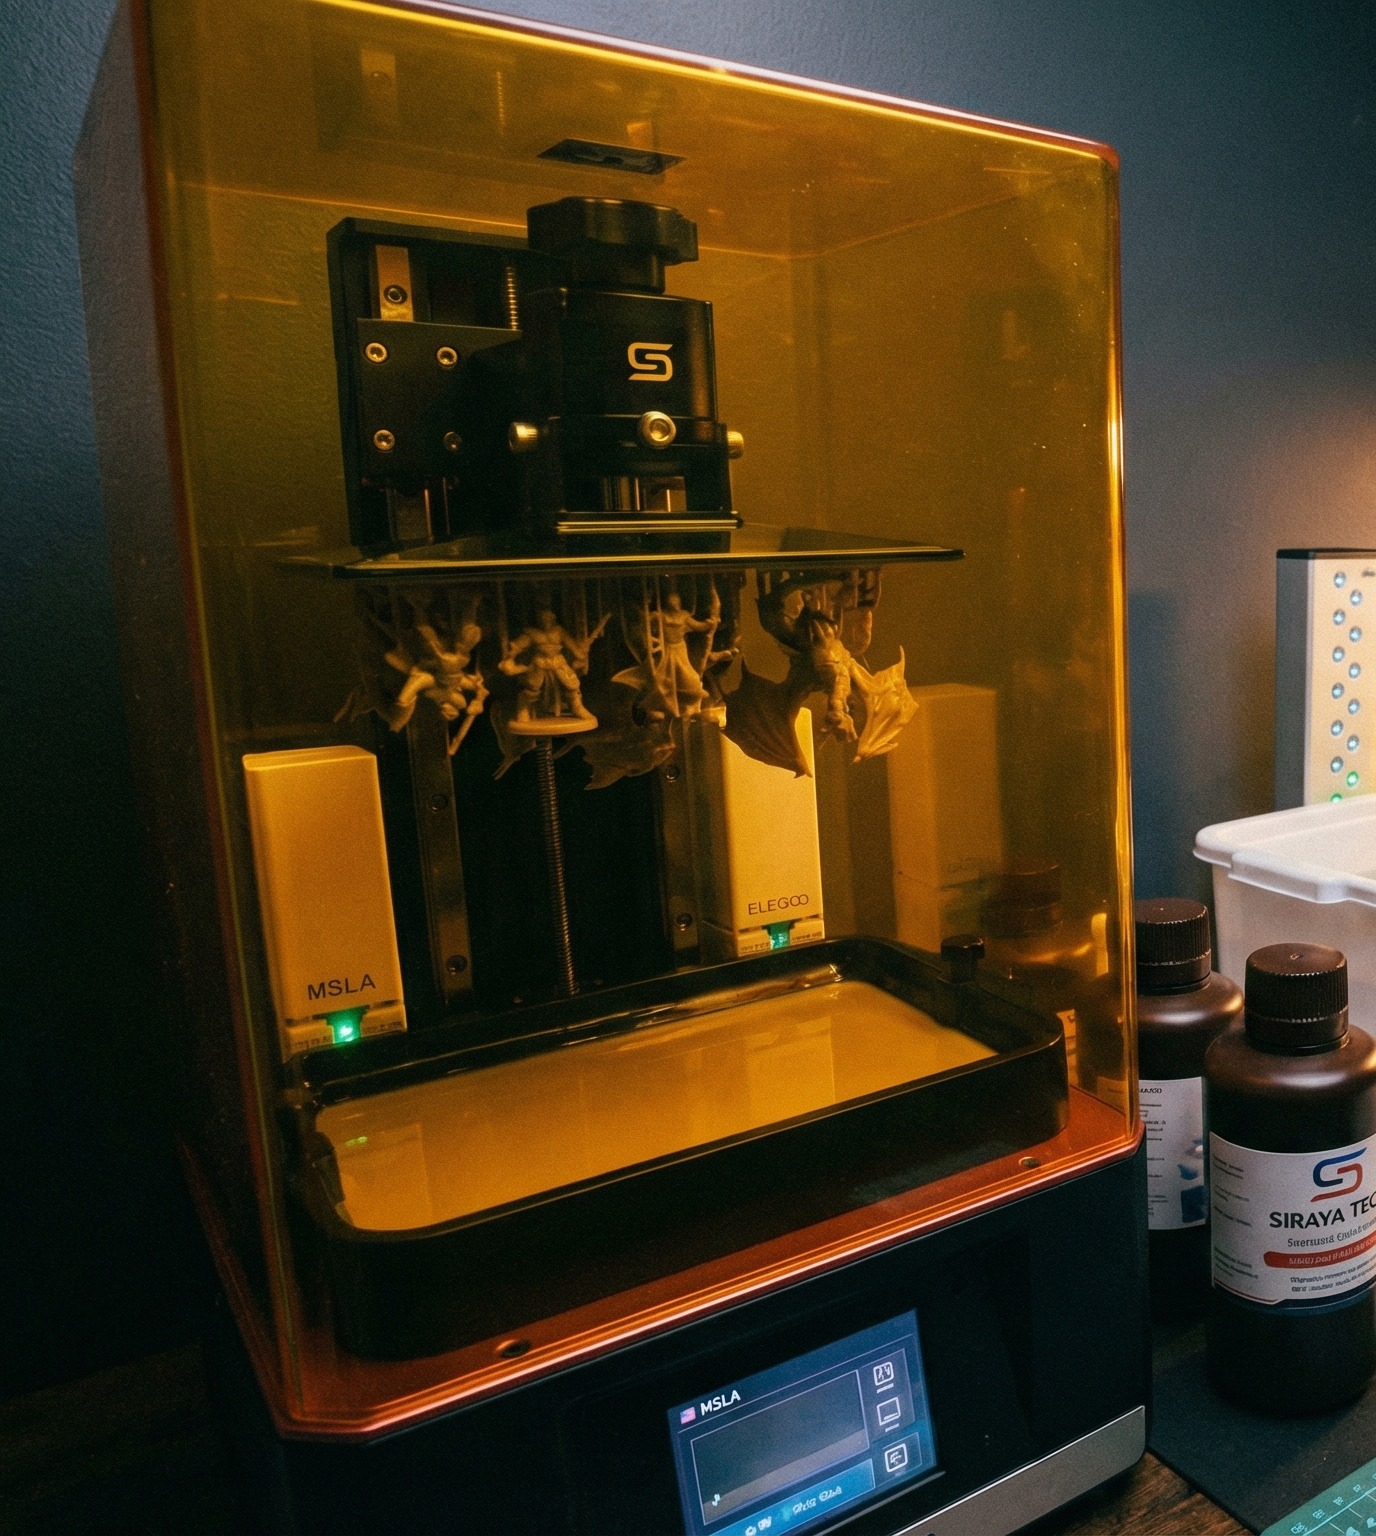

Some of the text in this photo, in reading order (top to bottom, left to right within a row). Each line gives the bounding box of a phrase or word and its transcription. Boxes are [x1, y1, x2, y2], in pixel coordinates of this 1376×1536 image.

[747, 894, 809, 915] ELEGOO
[307, 974, 376, 1001] MSLA
[1269, 1208, 1345, 1229] SIRAYA
[700, 1389, 741, 1416] MSLA
